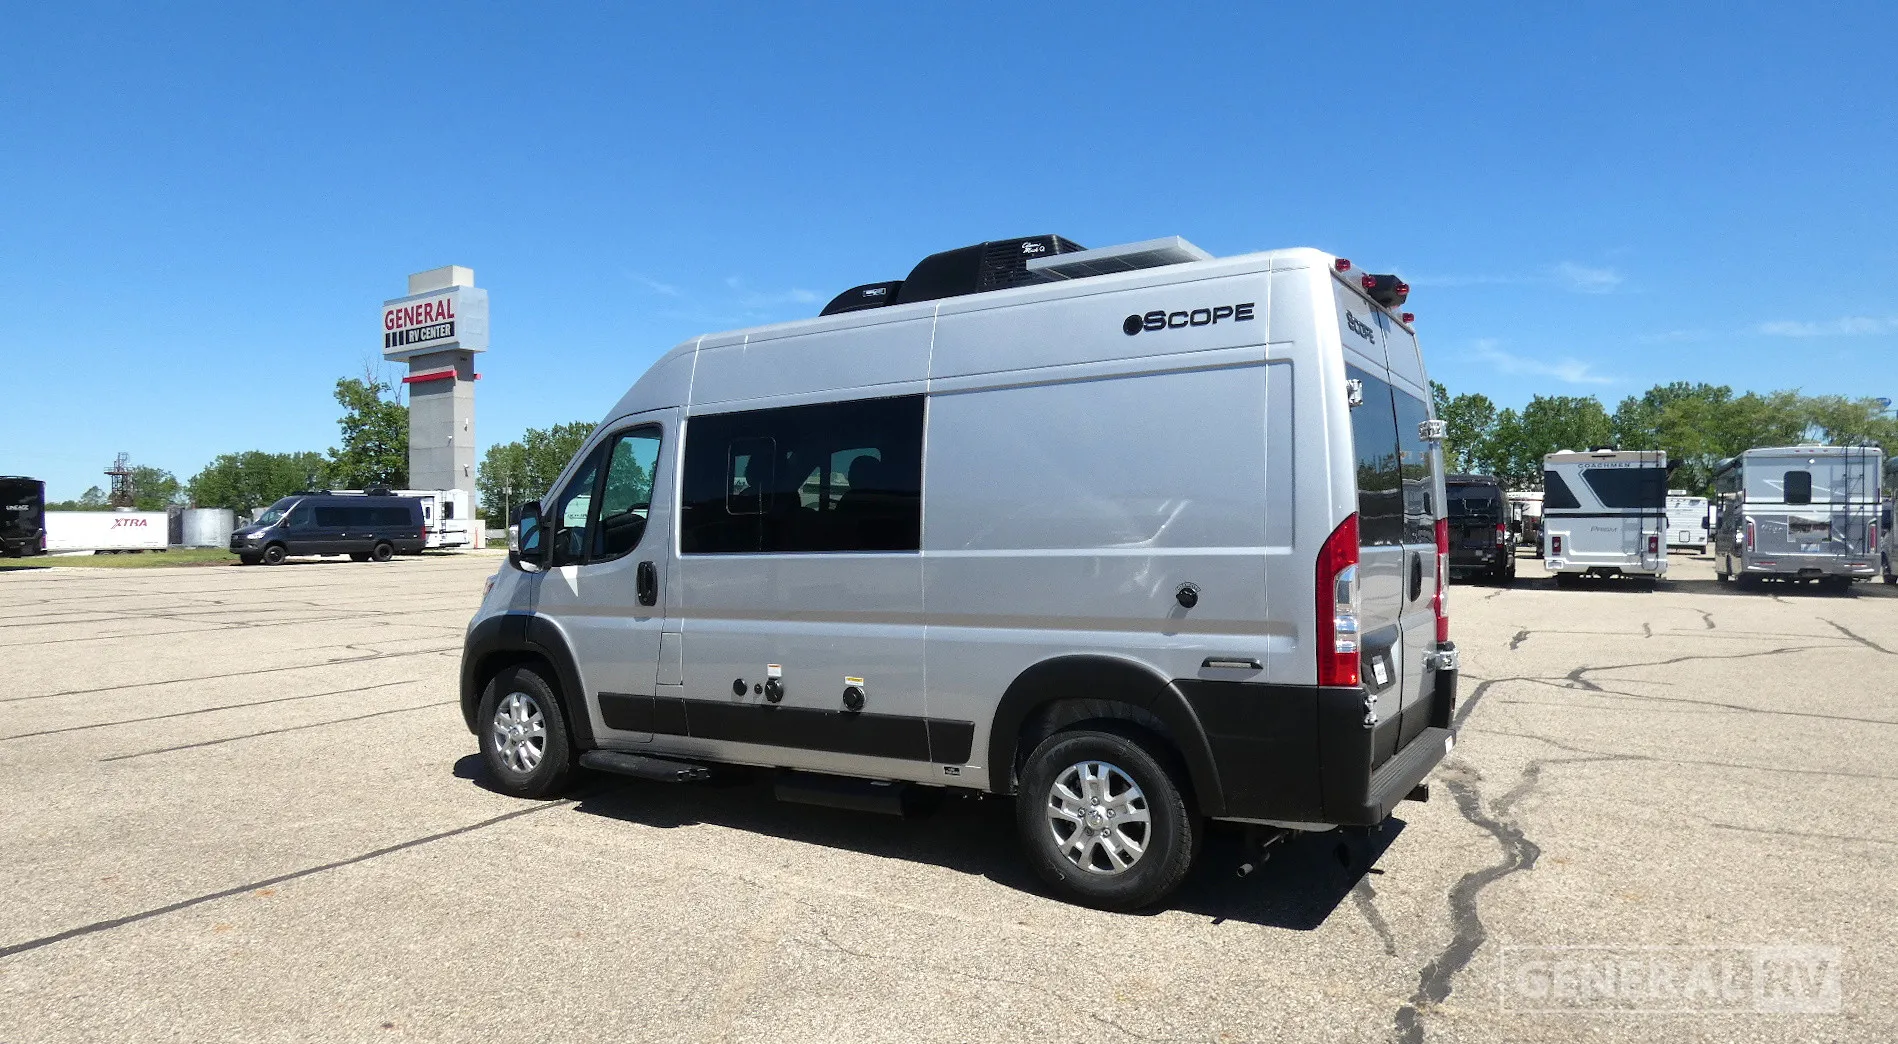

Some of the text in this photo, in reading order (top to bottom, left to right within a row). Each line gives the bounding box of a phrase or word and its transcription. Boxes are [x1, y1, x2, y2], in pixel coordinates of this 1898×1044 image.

[385, 298, 455, 331] GENERAL
[1143, 302, 1255, 332] SCOPE
[408, 323, 451, 342] RV CENTER
[110, 518, 148, 529] XTRA
